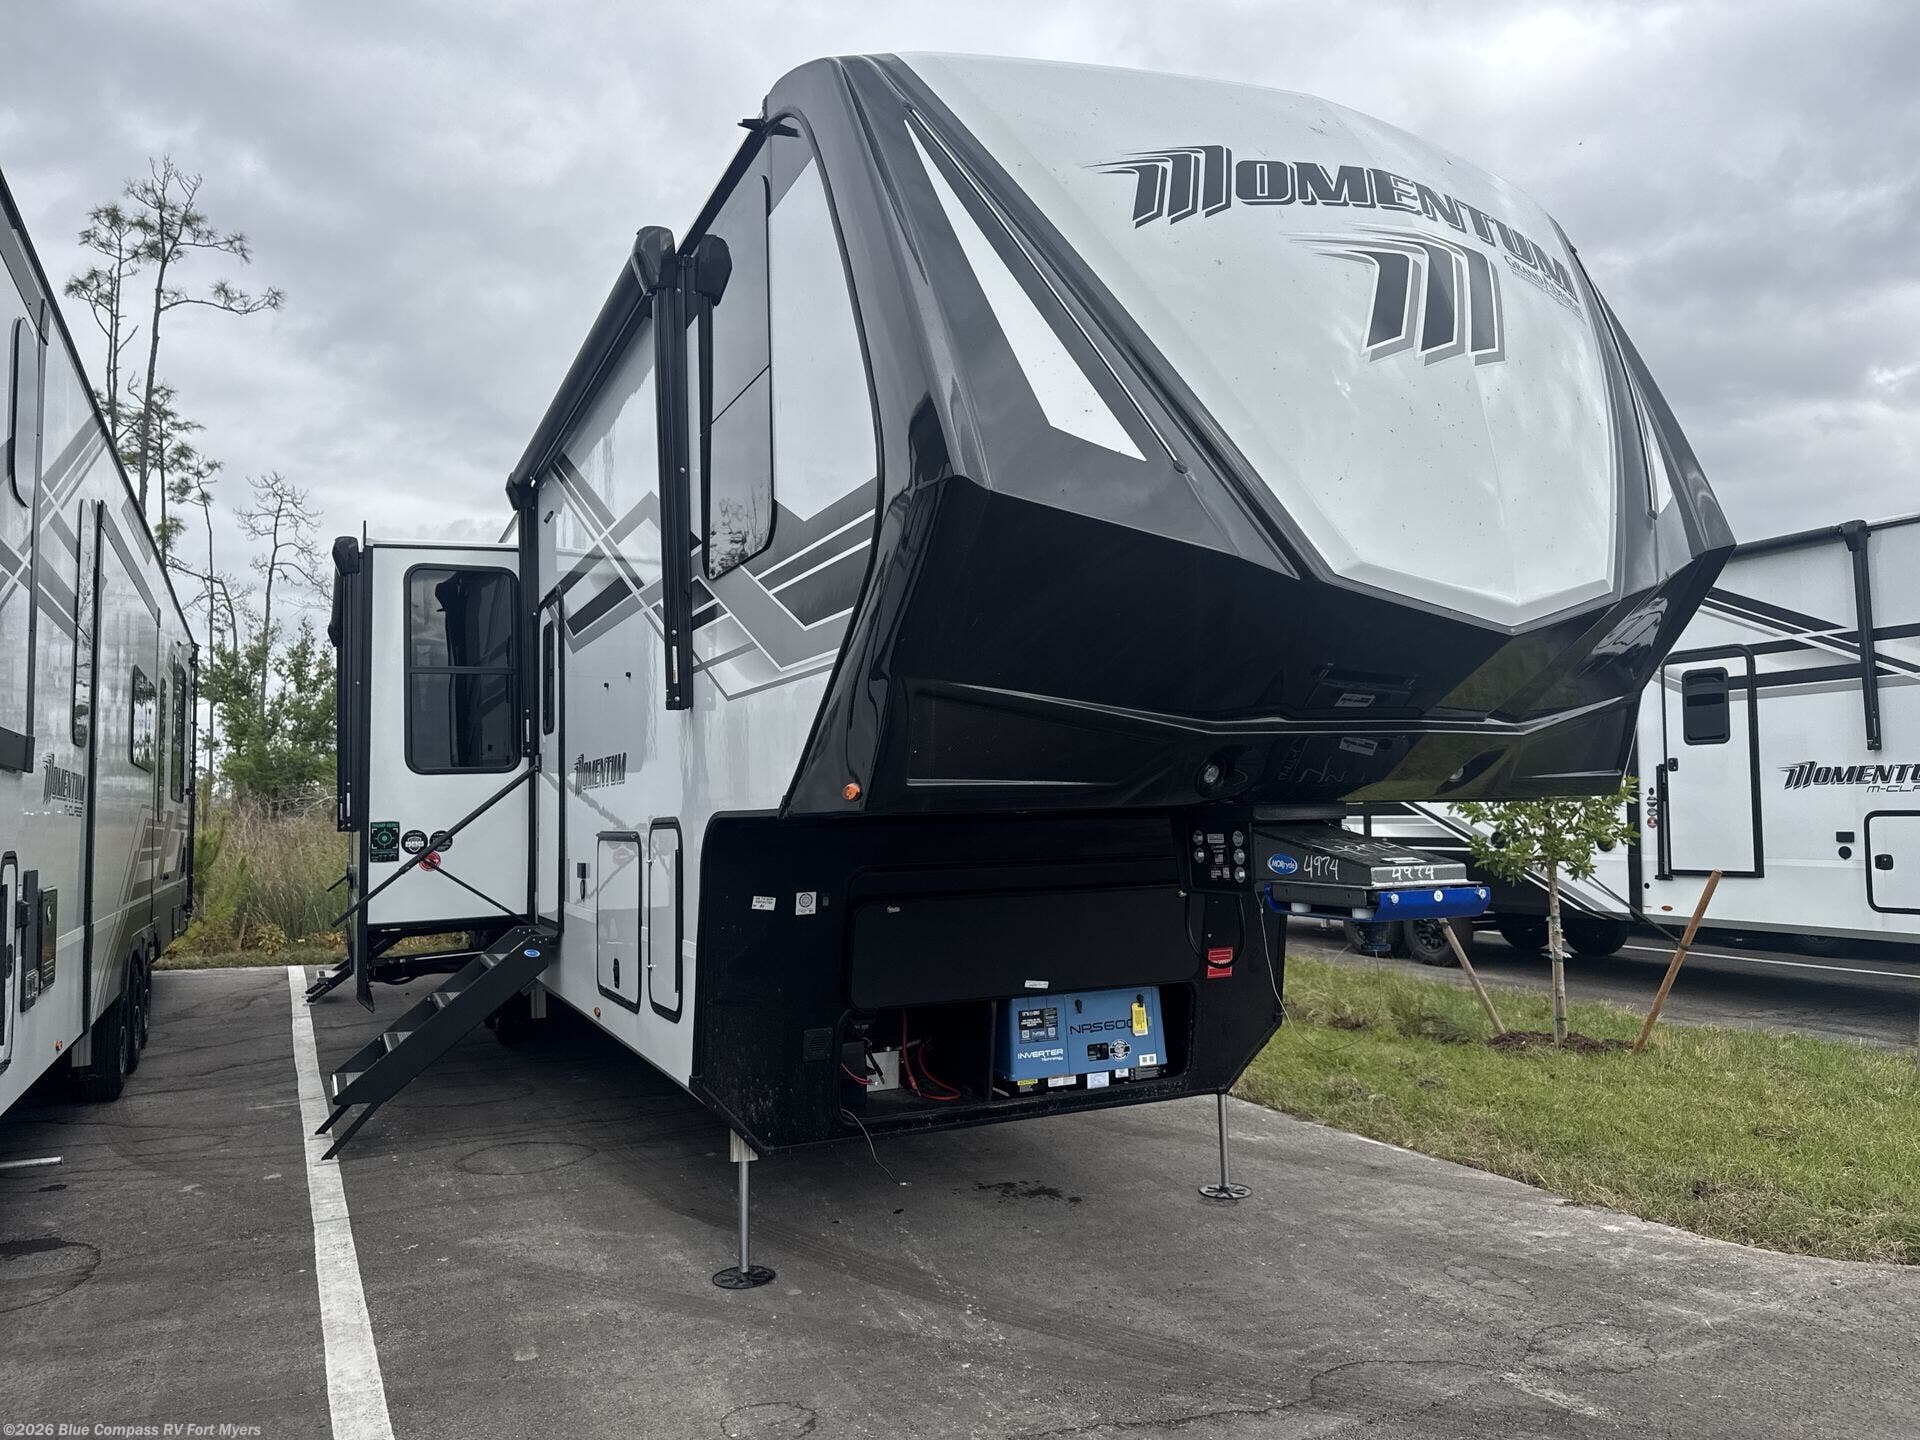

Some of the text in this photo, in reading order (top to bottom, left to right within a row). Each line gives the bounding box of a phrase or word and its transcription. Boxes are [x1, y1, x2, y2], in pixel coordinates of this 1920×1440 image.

[1084, 144, 1579, 304] MOMENTUM
[574, 751, 627, 797] MOMENTUM
[1303, 855, 1339, 881] 4974
[1391, 864, 1435, 881] 4974
[1017, 1048, 1064, 1060] INVERTER
